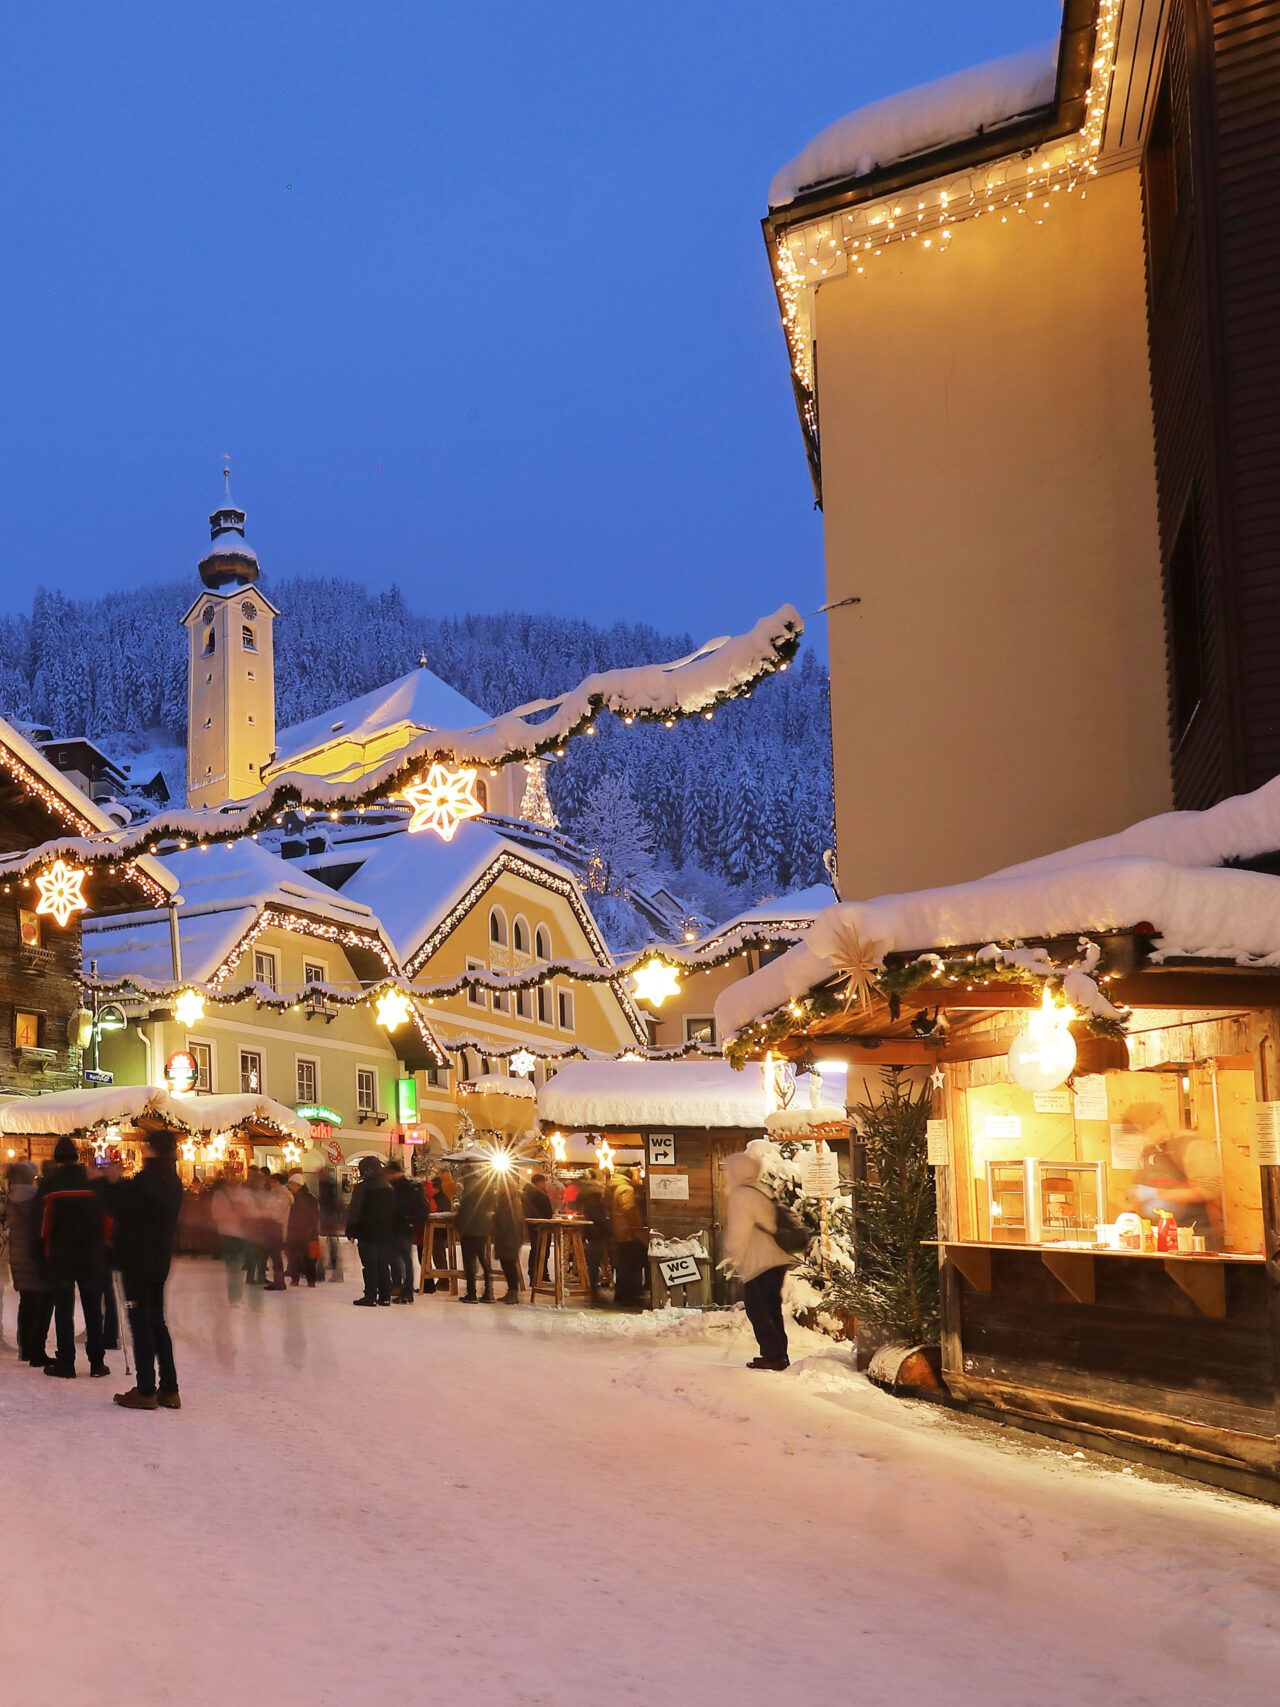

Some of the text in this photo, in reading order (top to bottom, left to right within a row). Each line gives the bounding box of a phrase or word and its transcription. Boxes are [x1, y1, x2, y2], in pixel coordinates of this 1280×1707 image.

[19, 1023, 31, 1045] 4
[651, 1138, 672, 1147] WC
[666, 1260, 690, 1273] WC
